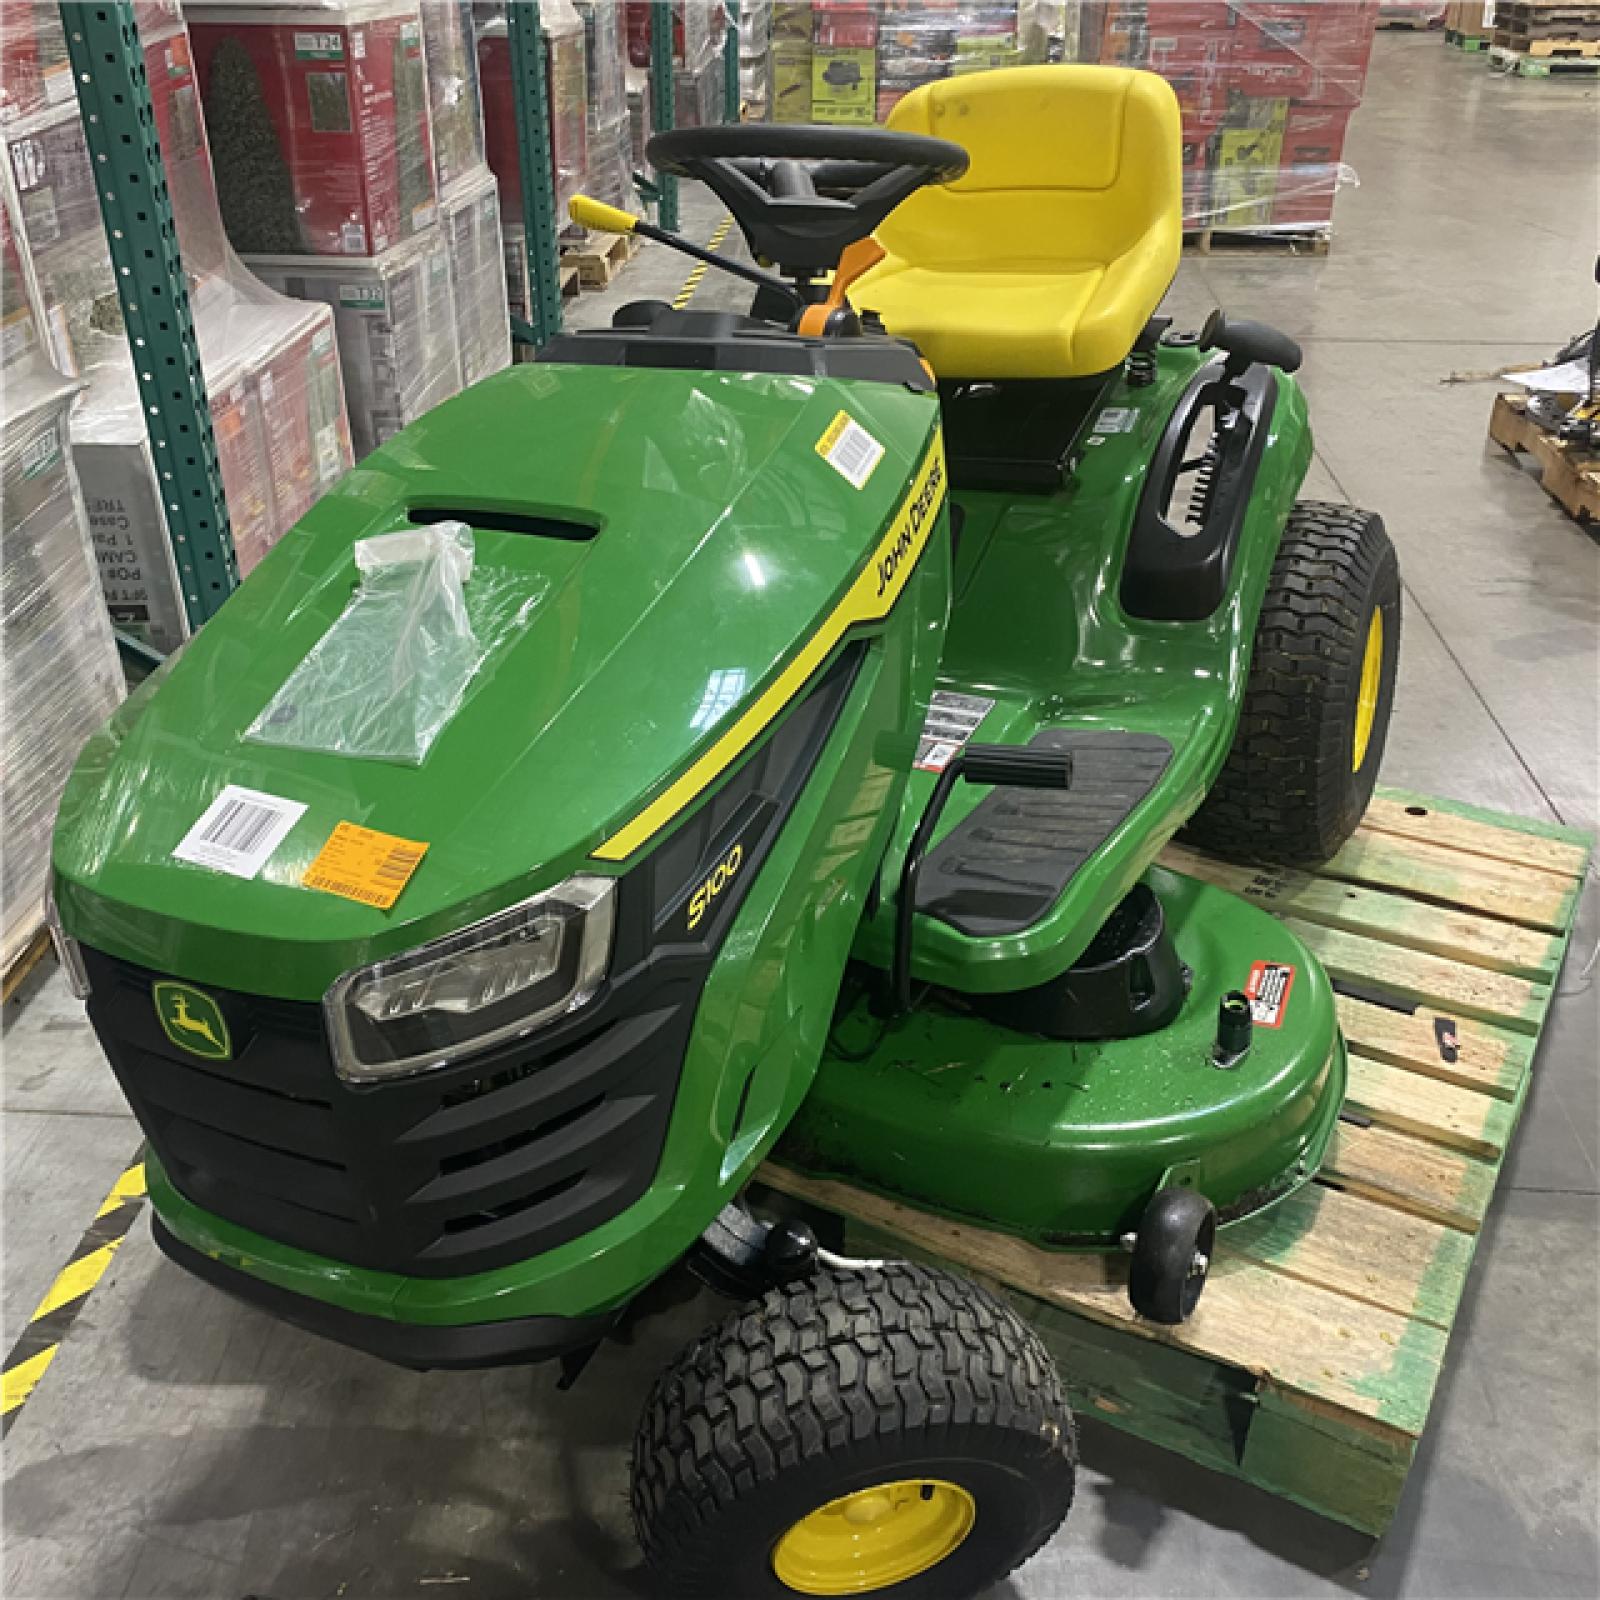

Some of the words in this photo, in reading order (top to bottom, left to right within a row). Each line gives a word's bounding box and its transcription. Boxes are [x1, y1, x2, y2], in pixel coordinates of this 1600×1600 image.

[877, 522, 912, 597] JOHN
[910, 456, 943, 534] DEERE
[687, 844, 743, 932] S100
